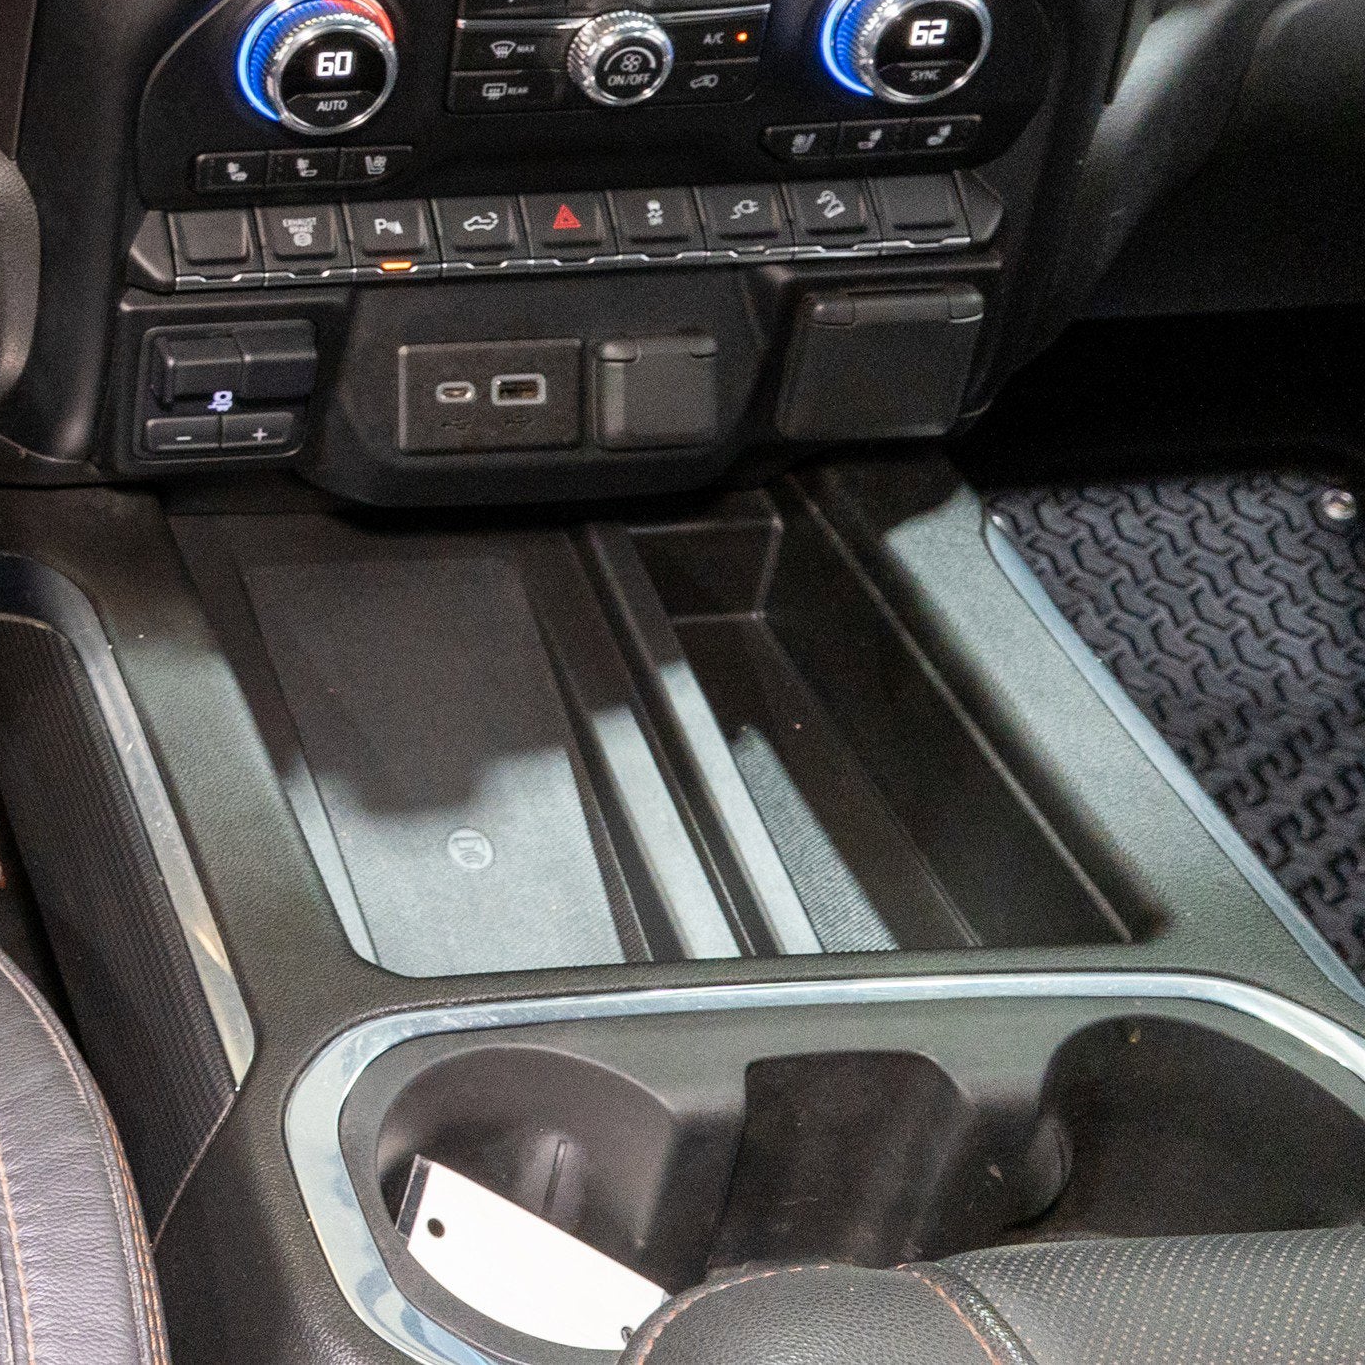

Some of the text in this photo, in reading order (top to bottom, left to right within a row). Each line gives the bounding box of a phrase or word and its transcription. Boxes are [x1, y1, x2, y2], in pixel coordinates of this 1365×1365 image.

[703, 32, 725, 45] A/C
[909, 19, 949, 47] 62
[316, 51, 353, 77] 60
[608, 73, 652, 87] ON/OFF
[316, 100, 349, 112] AUTO
